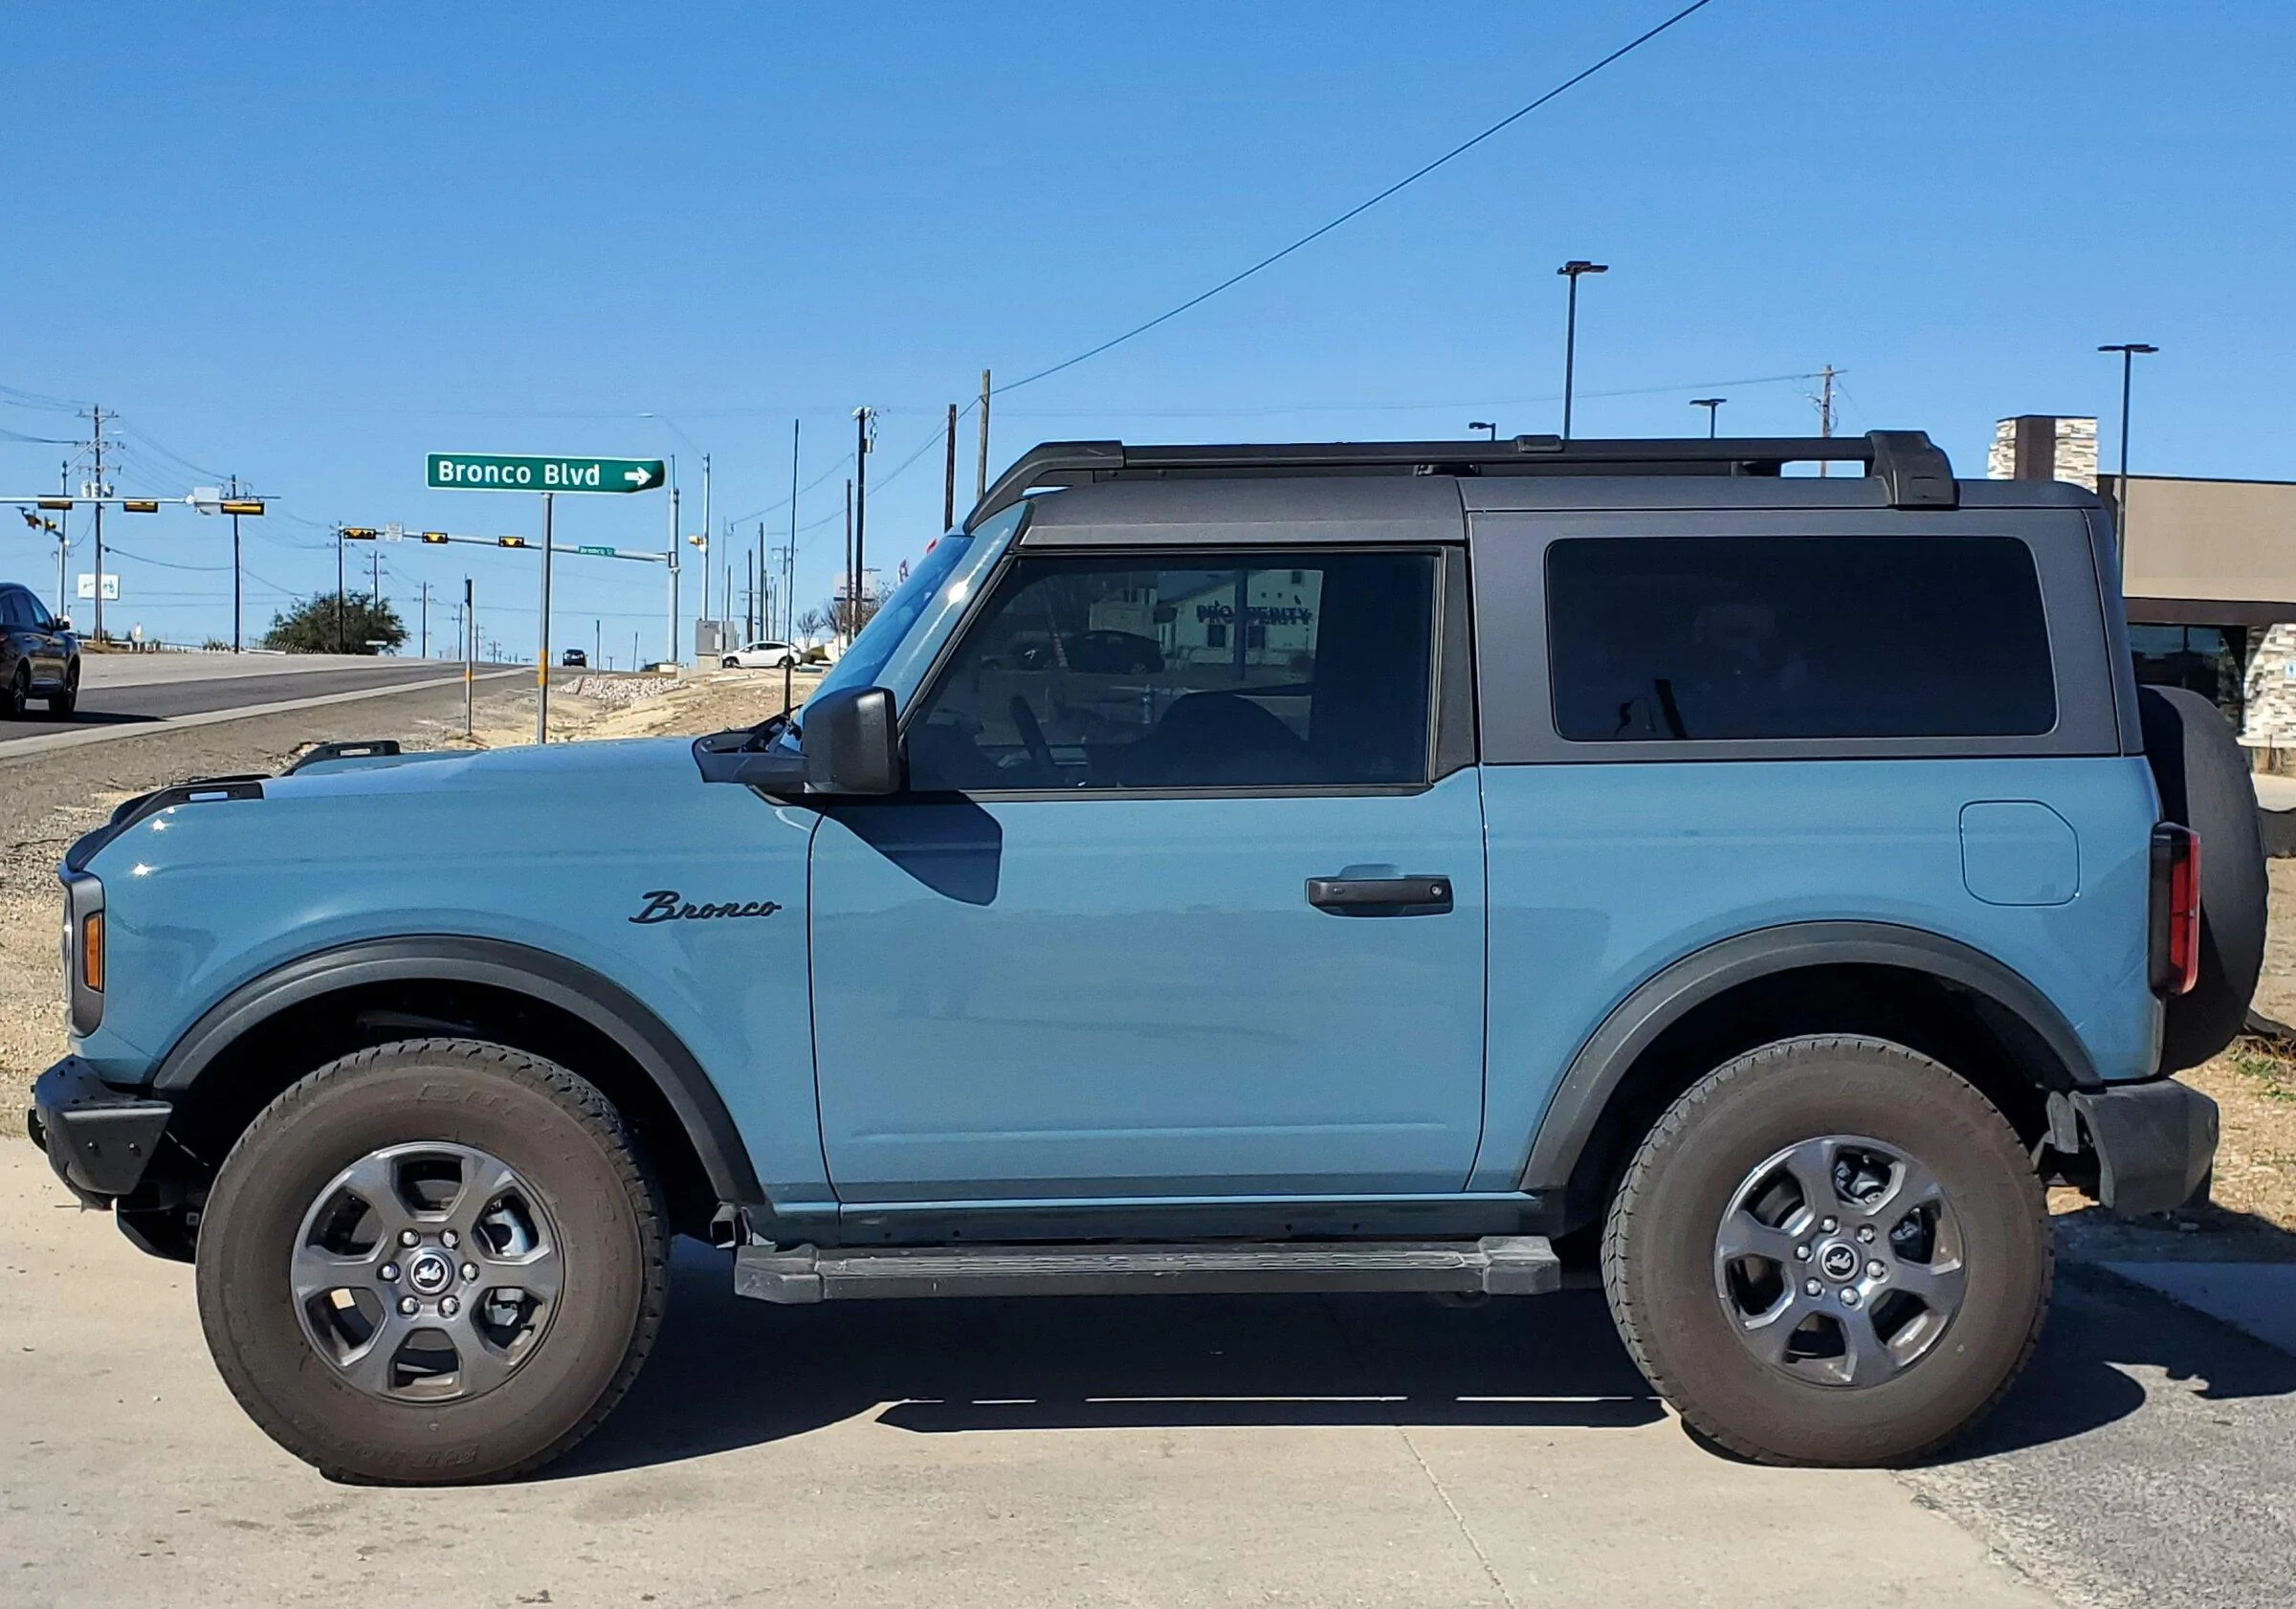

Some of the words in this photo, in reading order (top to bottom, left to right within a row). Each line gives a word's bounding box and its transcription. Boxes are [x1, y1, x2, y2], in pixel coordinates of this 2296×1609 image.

[438, 460, 531, 483] Bronco
[544, 464, 600, 486] Blvd
[628, 890, 782, 924] Bronco
